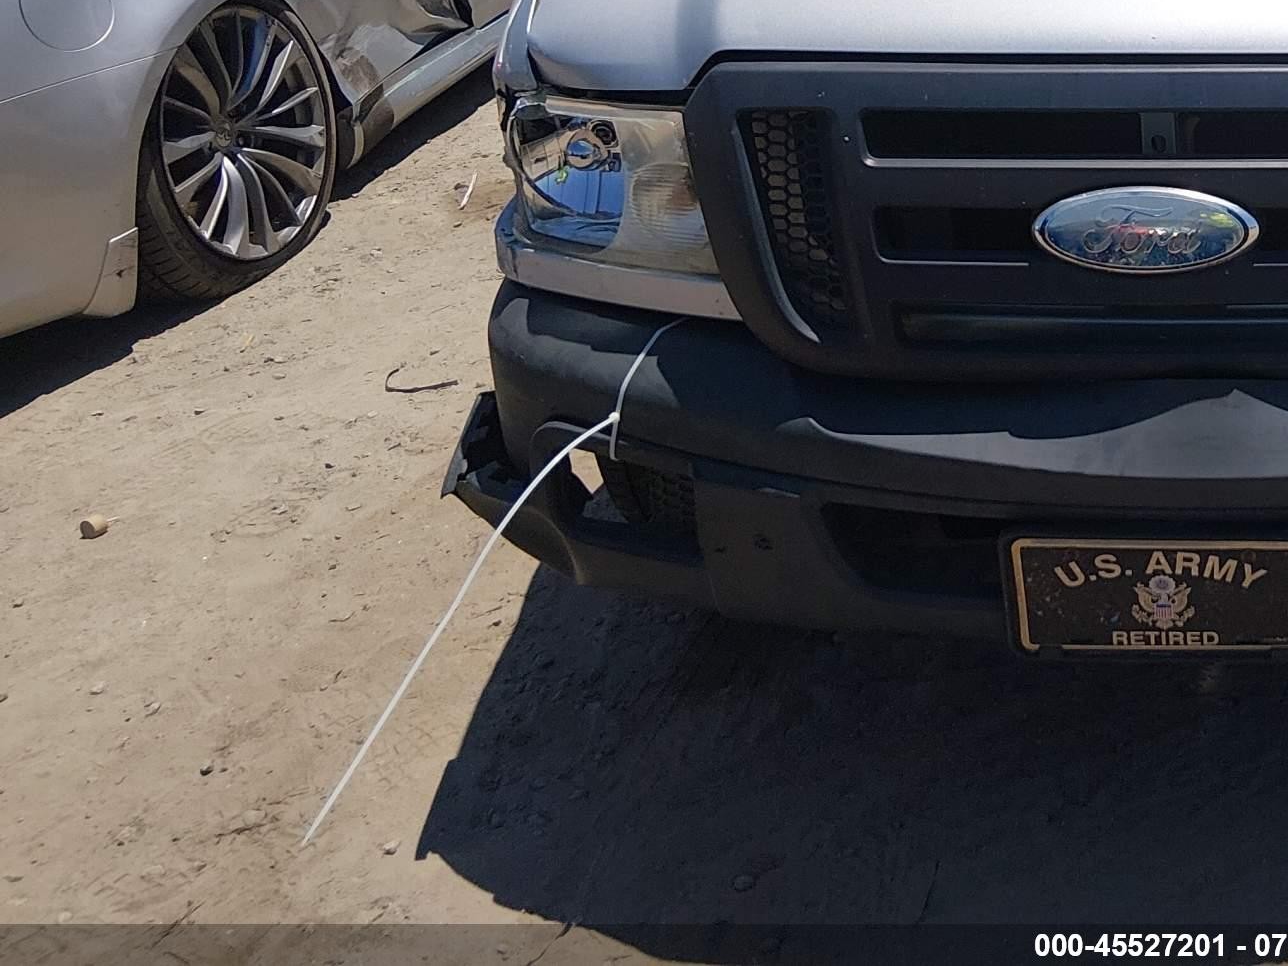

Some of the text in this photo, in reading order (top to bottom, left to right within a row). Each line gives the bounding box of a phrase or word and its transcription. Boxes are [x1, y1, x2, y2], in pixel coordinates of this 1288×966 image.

[1081, 203, 1203, 255] Ford
[1053, 550, 1268, 589] U.S. ARMY
[1112, 631, 1220, 646] RETIRED
